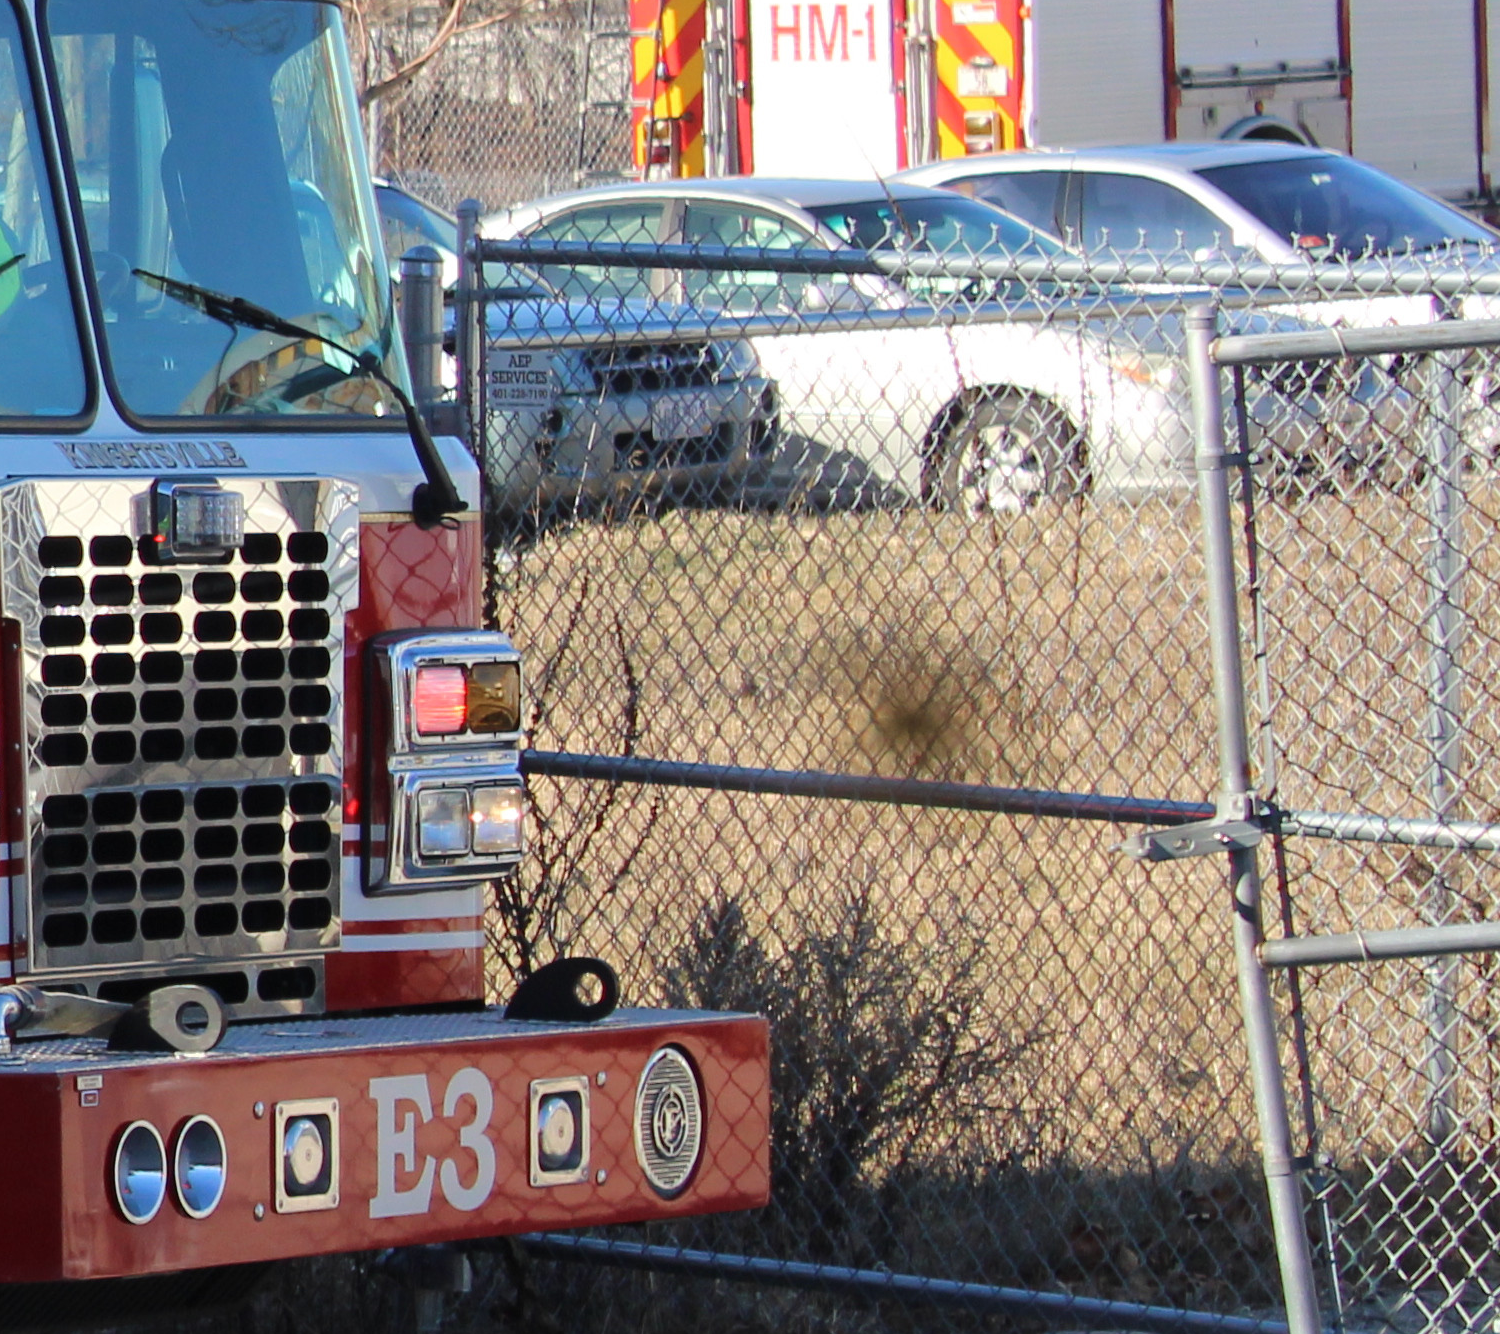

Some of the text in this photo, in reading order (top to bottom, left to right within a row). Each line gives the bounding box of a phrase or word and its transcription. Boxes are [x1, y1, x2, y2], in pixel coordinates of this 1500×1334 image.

[769, 3, 878, 62] HM-1
[509, 354, 532, 367] AEP
[492, 371, 547, 384] SERVICES
[54, 441, 248, 469] KNIGHTSVILLE
[367, 1066, 496, 1219] E3
